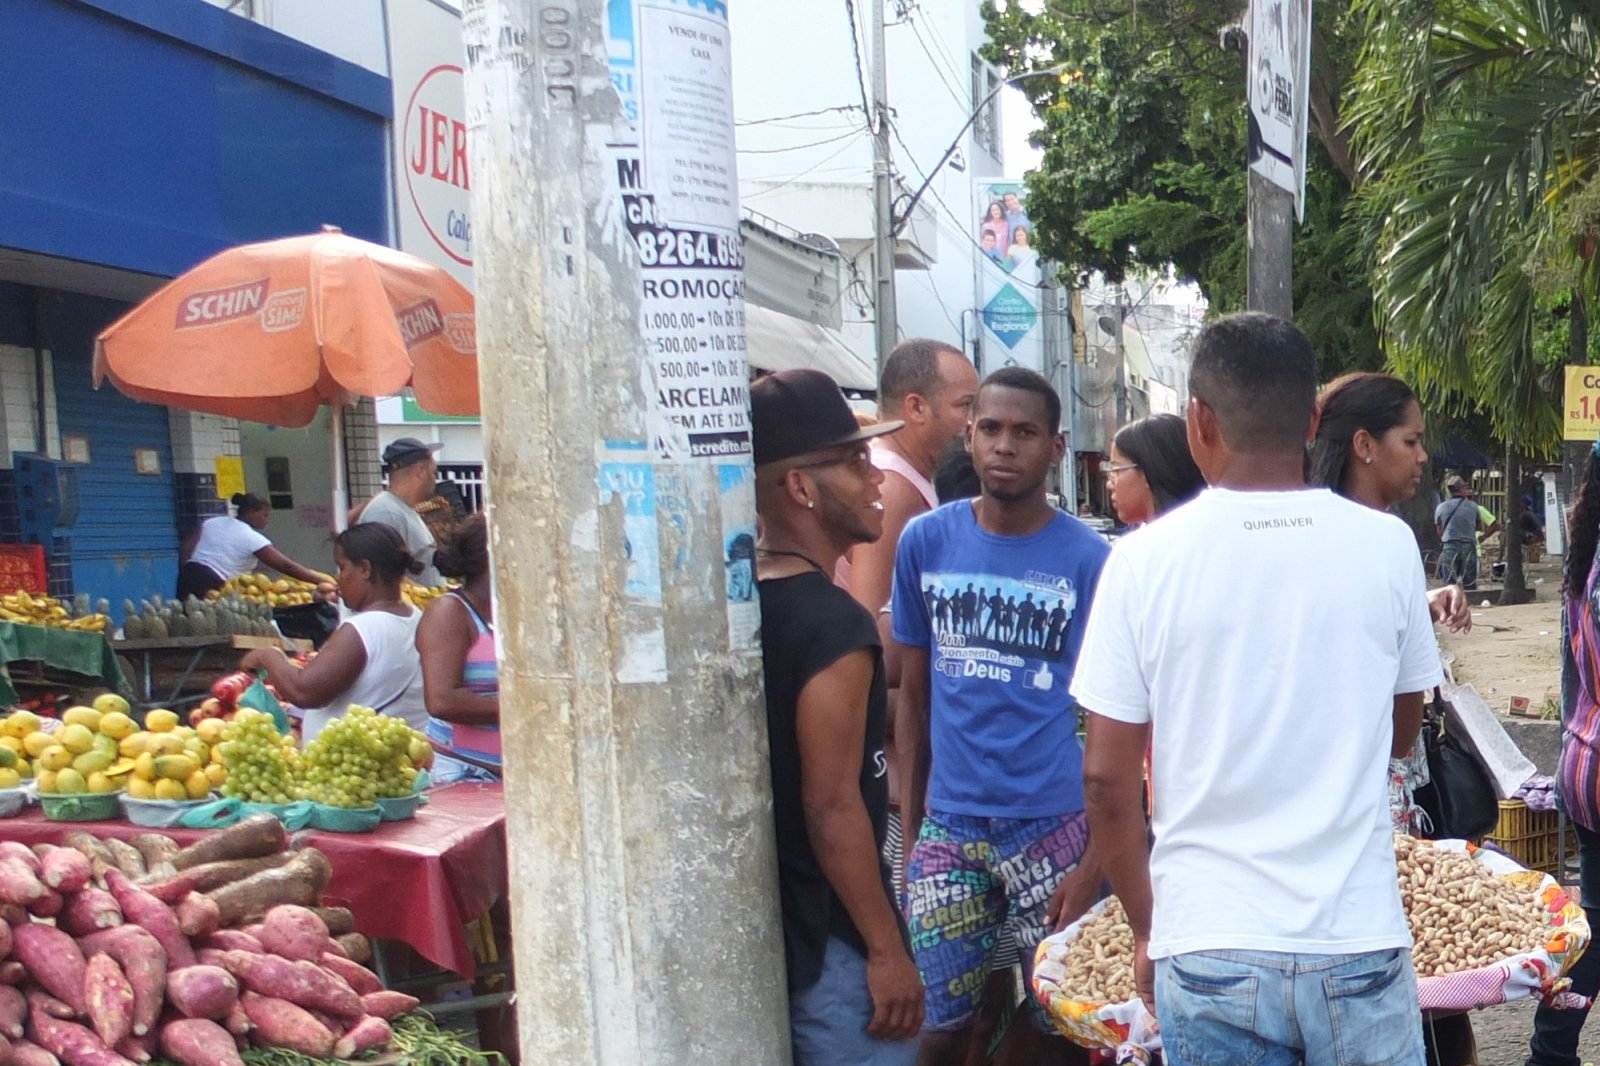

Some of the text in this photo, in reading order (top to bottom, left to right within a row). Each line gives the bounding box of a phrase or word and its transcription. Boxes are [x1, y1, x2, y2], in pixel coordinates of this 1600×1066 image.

[185, 286, 262, 322] SCHIN
[1243, 516, 1314, 531] QUIKSILVER
[963, 659, 1012, 683] Deus
[921, 895, 988, 930] GREAT
